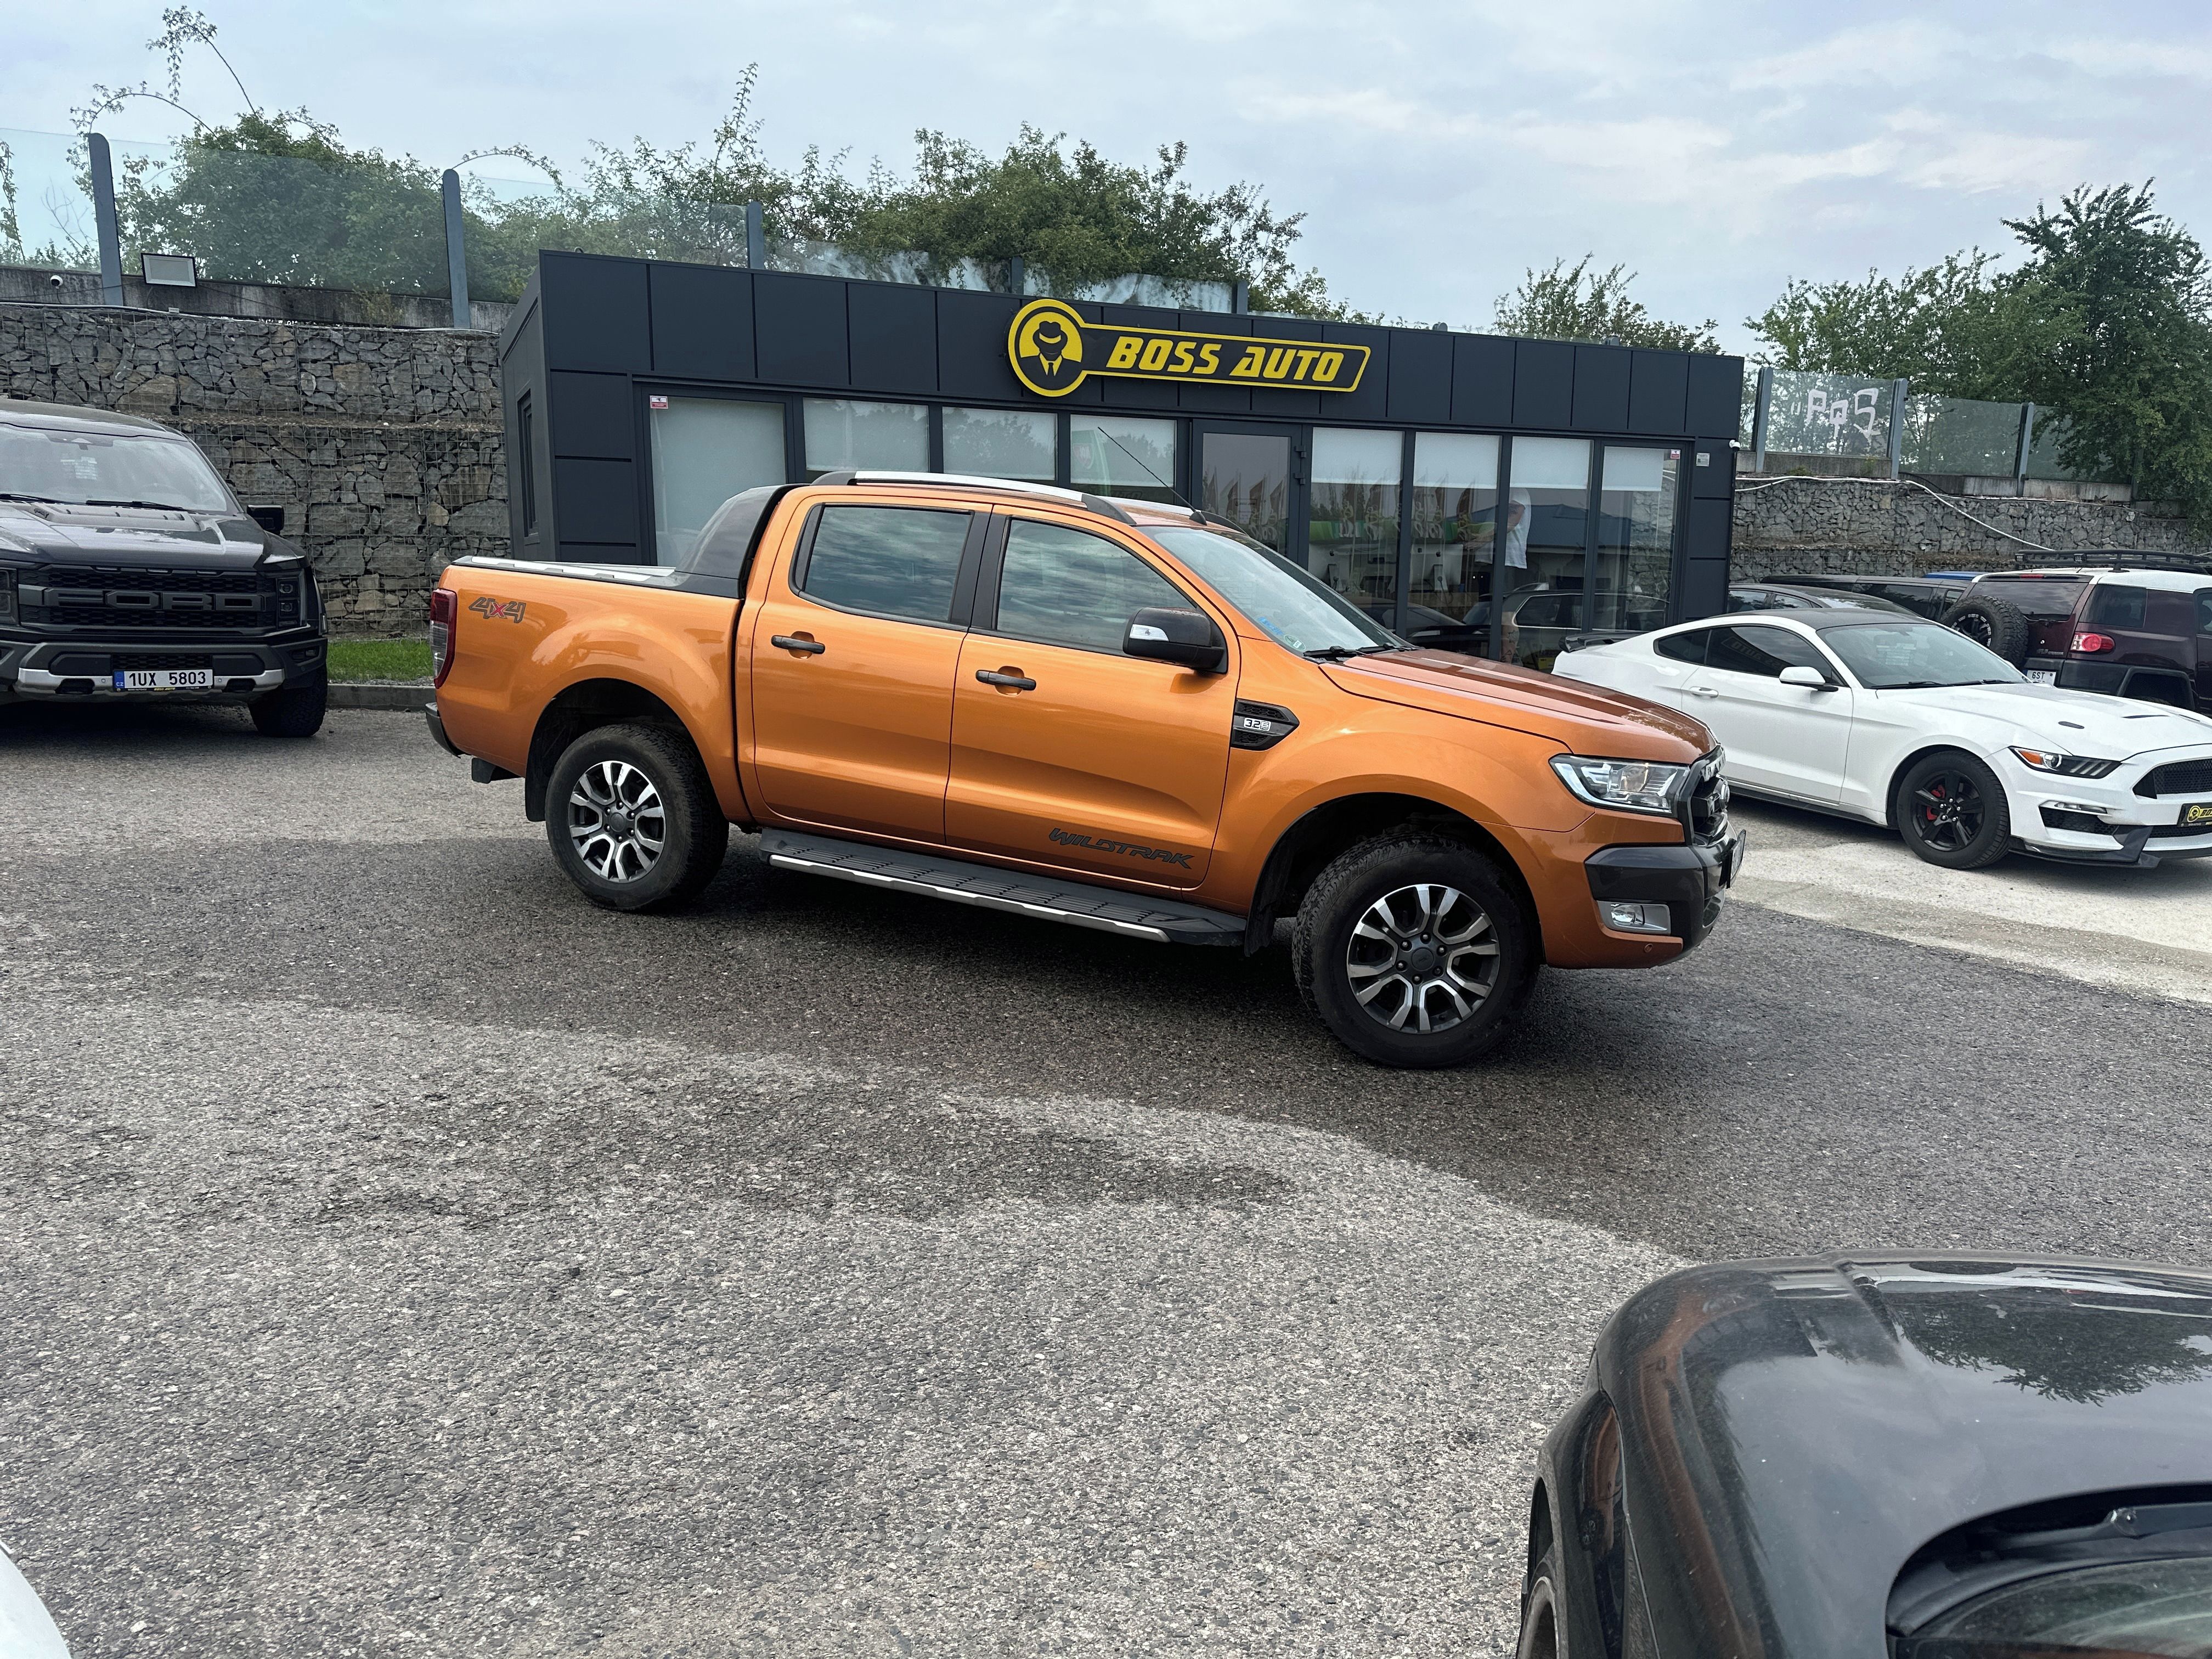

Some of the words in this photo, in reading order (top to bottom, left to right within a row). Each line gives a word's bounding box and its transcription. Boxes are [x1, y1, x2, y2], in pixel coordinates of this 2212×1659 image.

[1106, 335, 1222, 374] BOSS
[1229, 346, 1344, 382] AUTO
[129, 673, 156, 686] 1UX
[169, 672, 206, 685] 5803
[2032, 672, 2045, 680] 6ST
[1048, 827, 1195, 870] WILDTRAK
